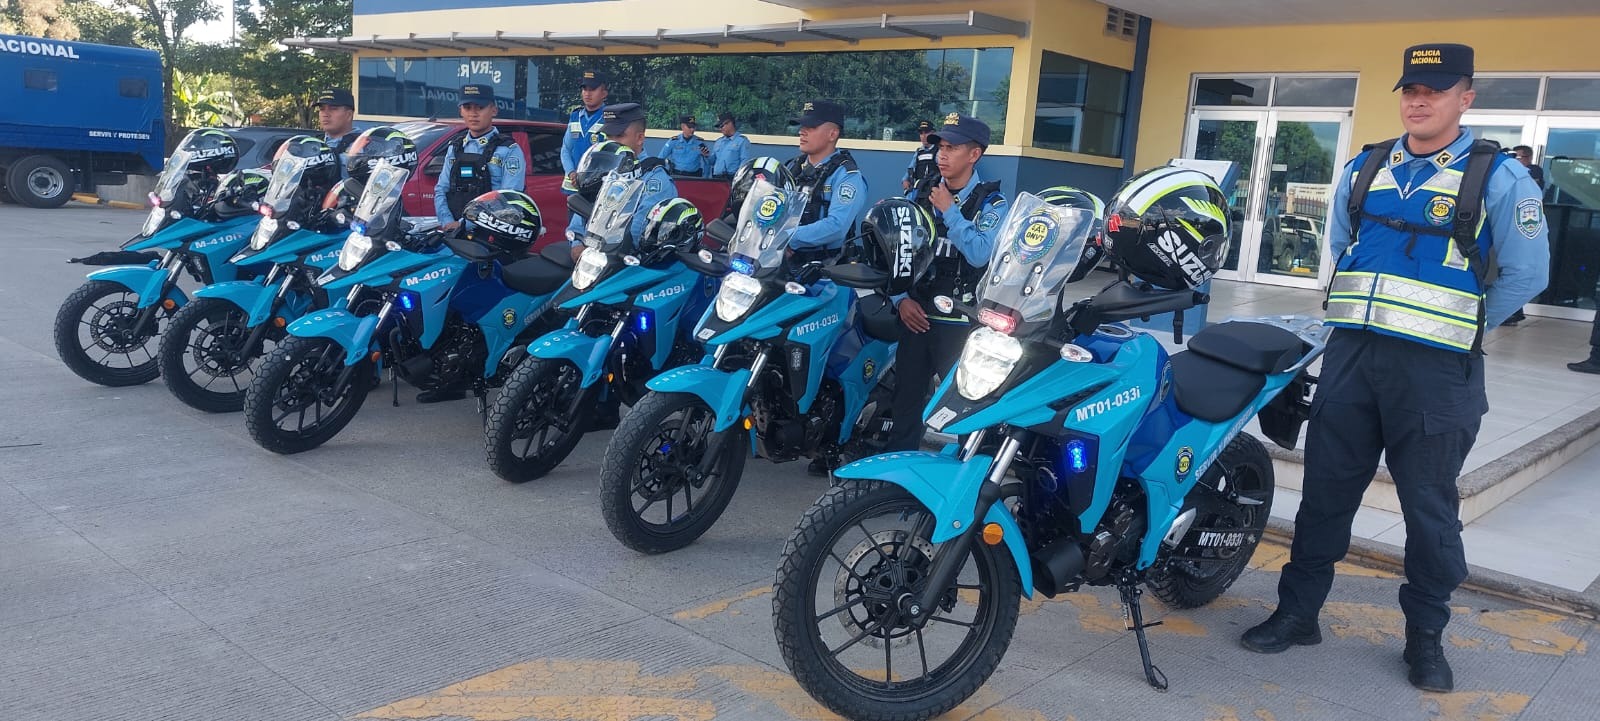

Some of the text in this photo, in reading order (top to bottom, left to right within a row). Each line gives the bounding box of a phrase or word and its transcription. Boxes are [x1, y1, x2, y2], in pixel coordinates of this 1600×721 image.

[1410, 56, 1443, 65] NACIONAL
[1412, 49, 1441, 57] POLICIA
[367, 151, 418, 171] SZUKI
[477, 211, 534, 239] SUZUKI
[897, 206, 913, 277] SUZUKI
[311, 250, 340, 263] M-40
[1157, 230, 1213, 284] SUZU
[406, 268, 451, 287] M-407i
[642, 283, 685, 303] M-409i
[796, 313, 839, 337] MT01-032i
[1075, 386, 1141, 422] MT01-033i
[1198, 531, 1244, 547] MT01-033i
